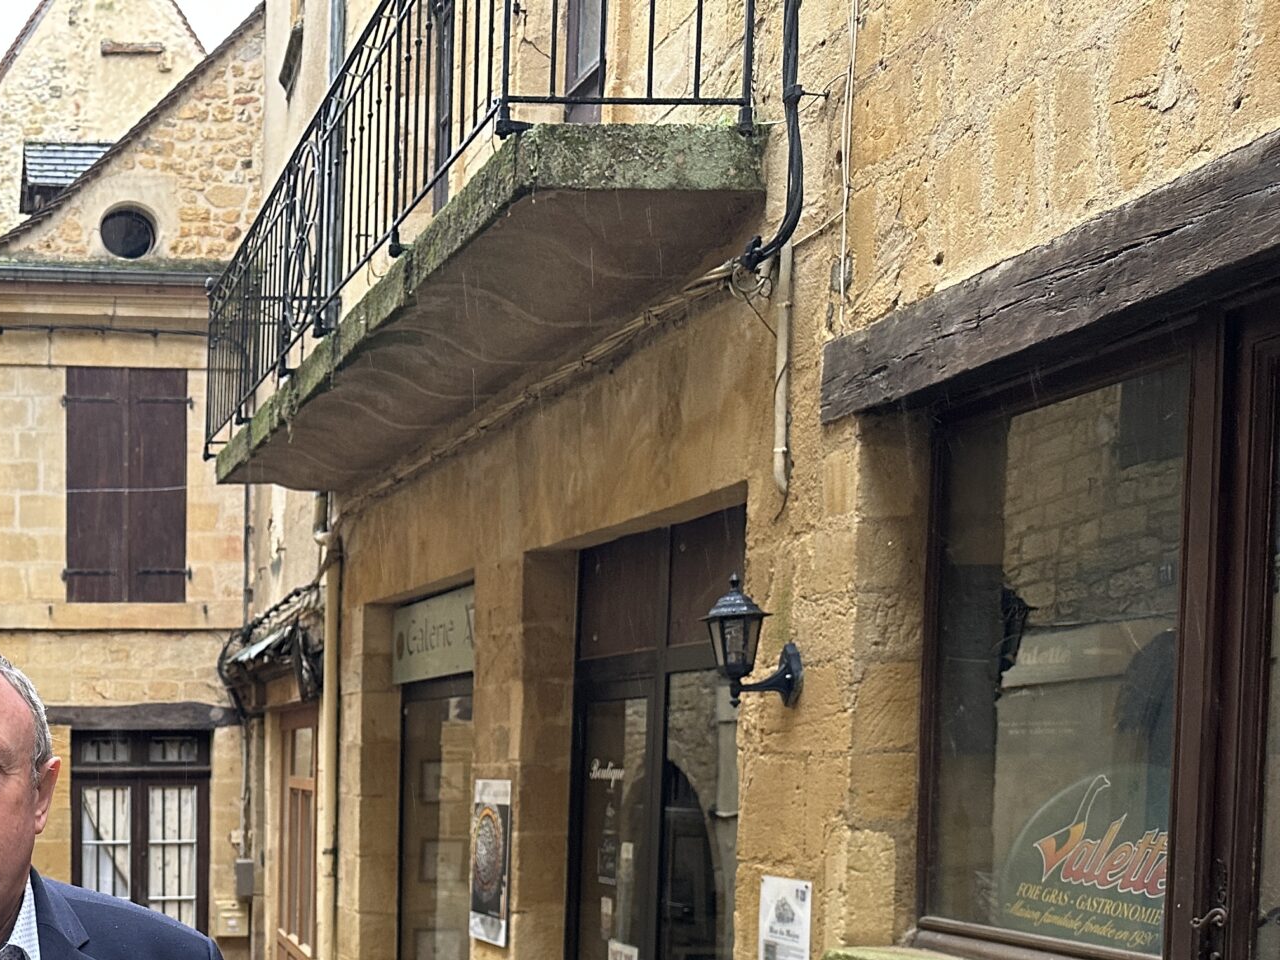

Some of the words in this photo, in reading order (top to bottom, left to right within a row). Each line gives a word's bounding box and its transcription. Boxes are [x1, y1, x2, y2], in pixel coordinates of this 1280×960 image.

[406, 618, 455, 656] Galerie
[589, 758, 625, 789] Boutique
[1033, 808, 1168, 898] Valette
[1017, 883, 1041, 899] FOIE
[1042, 888, 1069, 905] GRAS
[1076, 894, 1163, 926] GASTRONOMIE
[1115, 928, 1130, 940] en
